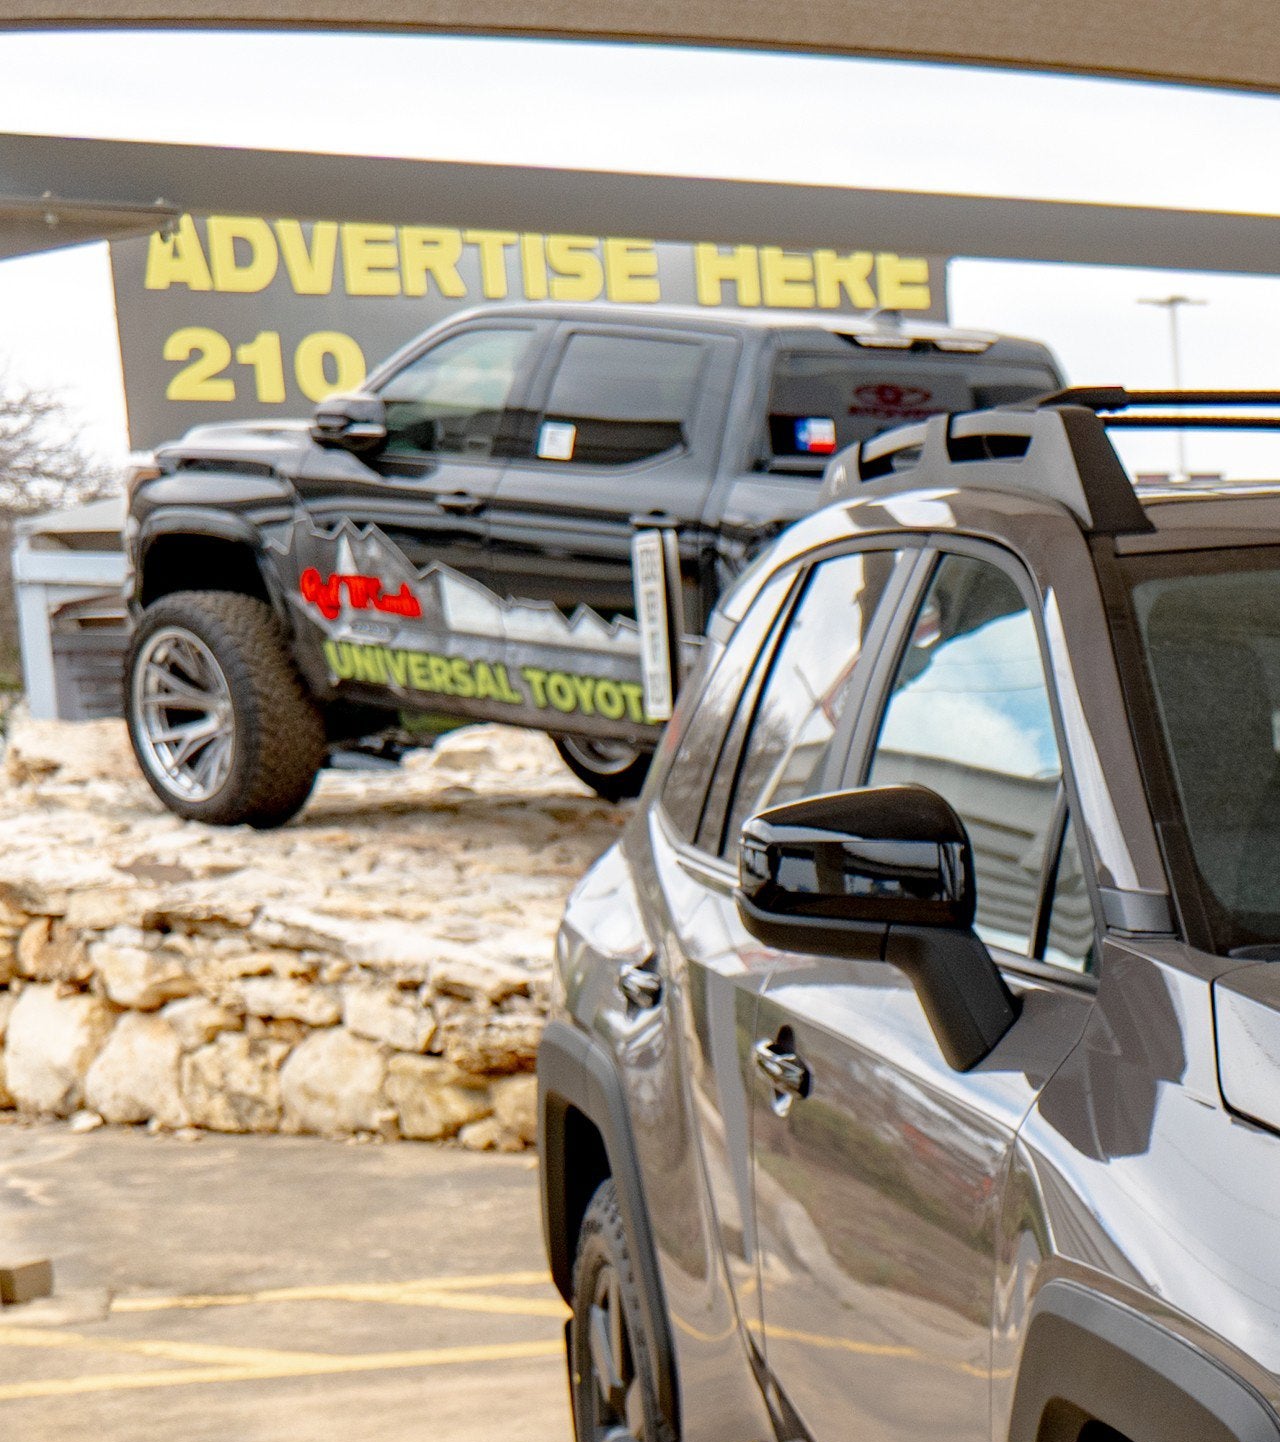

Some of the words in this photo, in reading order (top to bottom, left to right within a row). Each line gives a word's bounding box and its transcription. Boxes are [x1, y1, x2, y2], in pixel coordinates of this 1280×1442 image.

[144, 213, 662, 303] ADVERTISE
[694, 241, 932, 311] HERE
[163, 325, 367, 403] 210
[324, 638, 523, 705] UNIVERSAL
[522, 665, 672, 725] TOYOT
